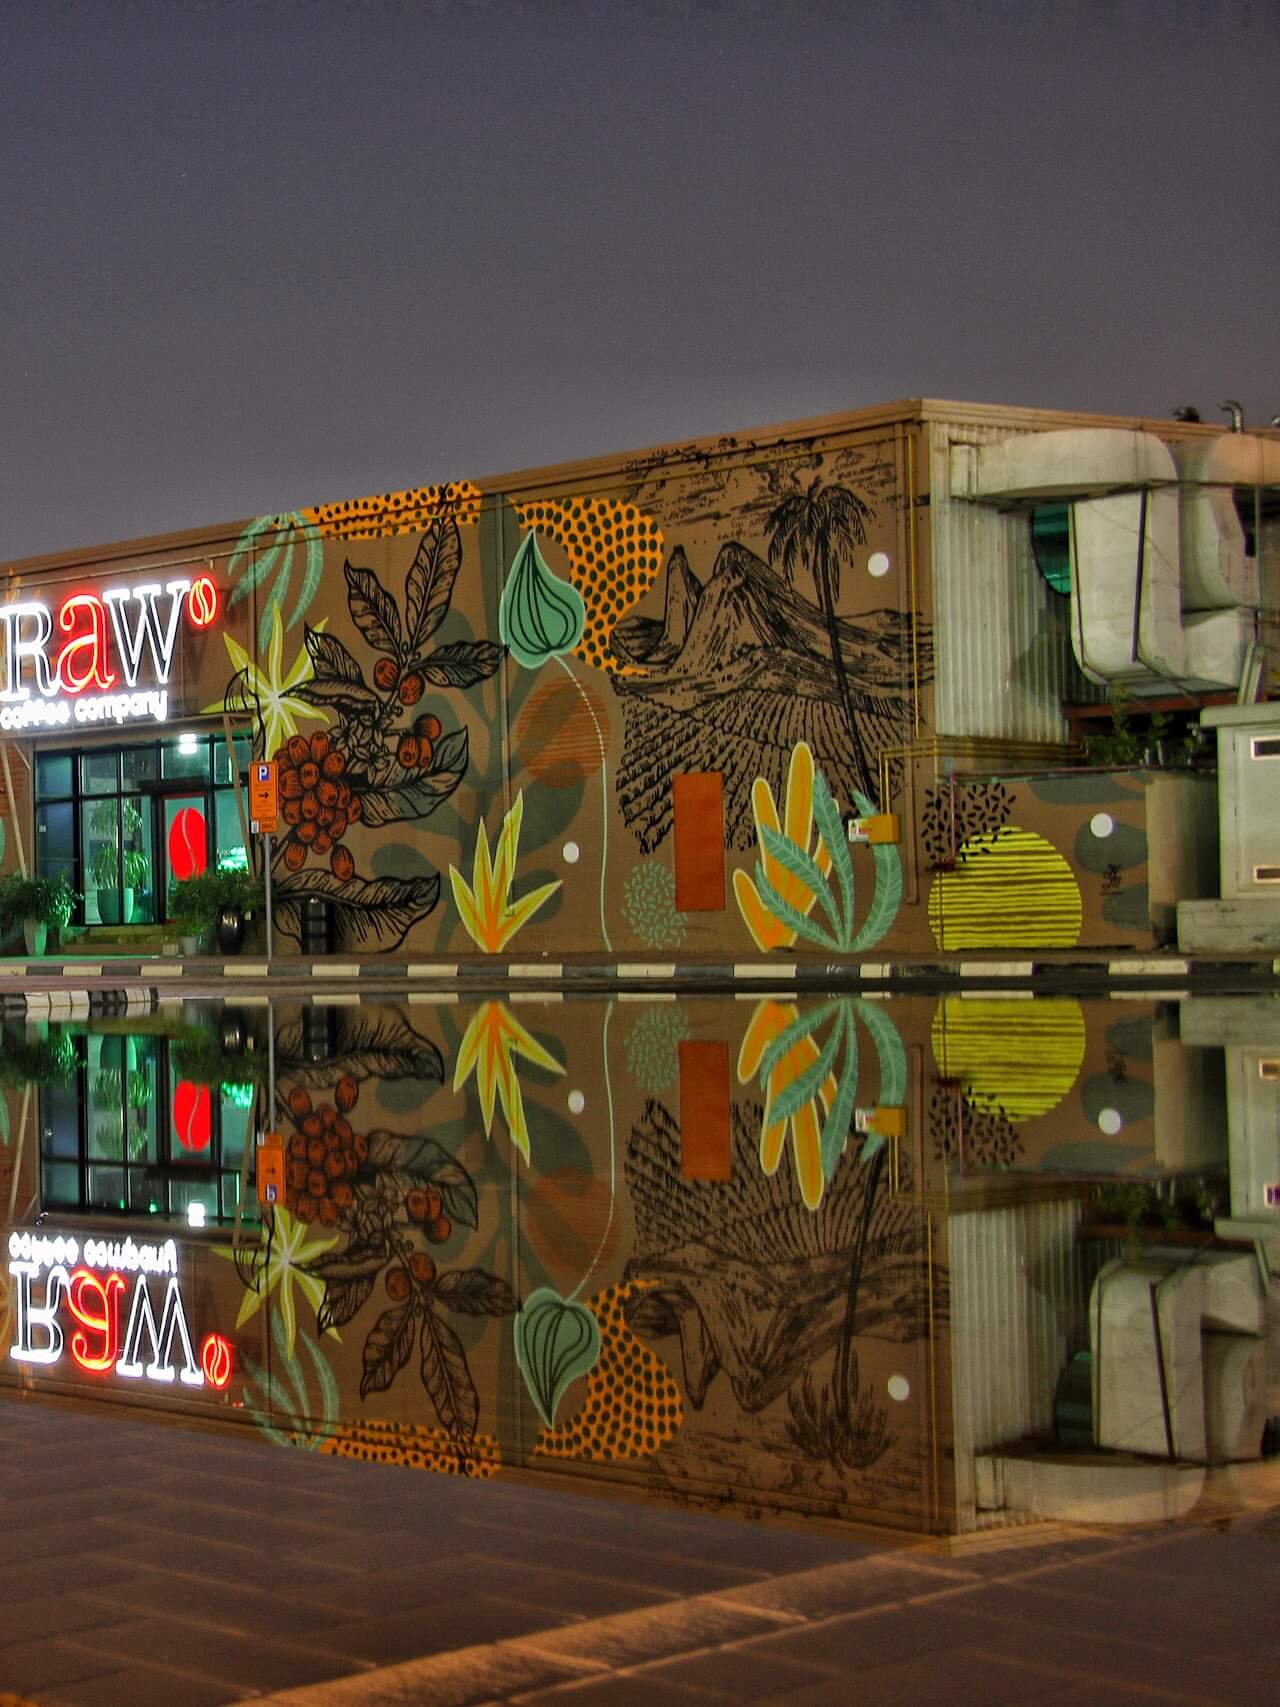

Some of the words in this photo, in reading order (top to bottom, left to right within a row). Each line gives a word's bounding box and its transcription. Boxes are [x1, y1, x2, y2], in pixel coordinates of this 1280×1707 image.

[0, 698, 70, 729] coffee
[74, 690, 167, 724] company
[259, 766, 268, 781] P
